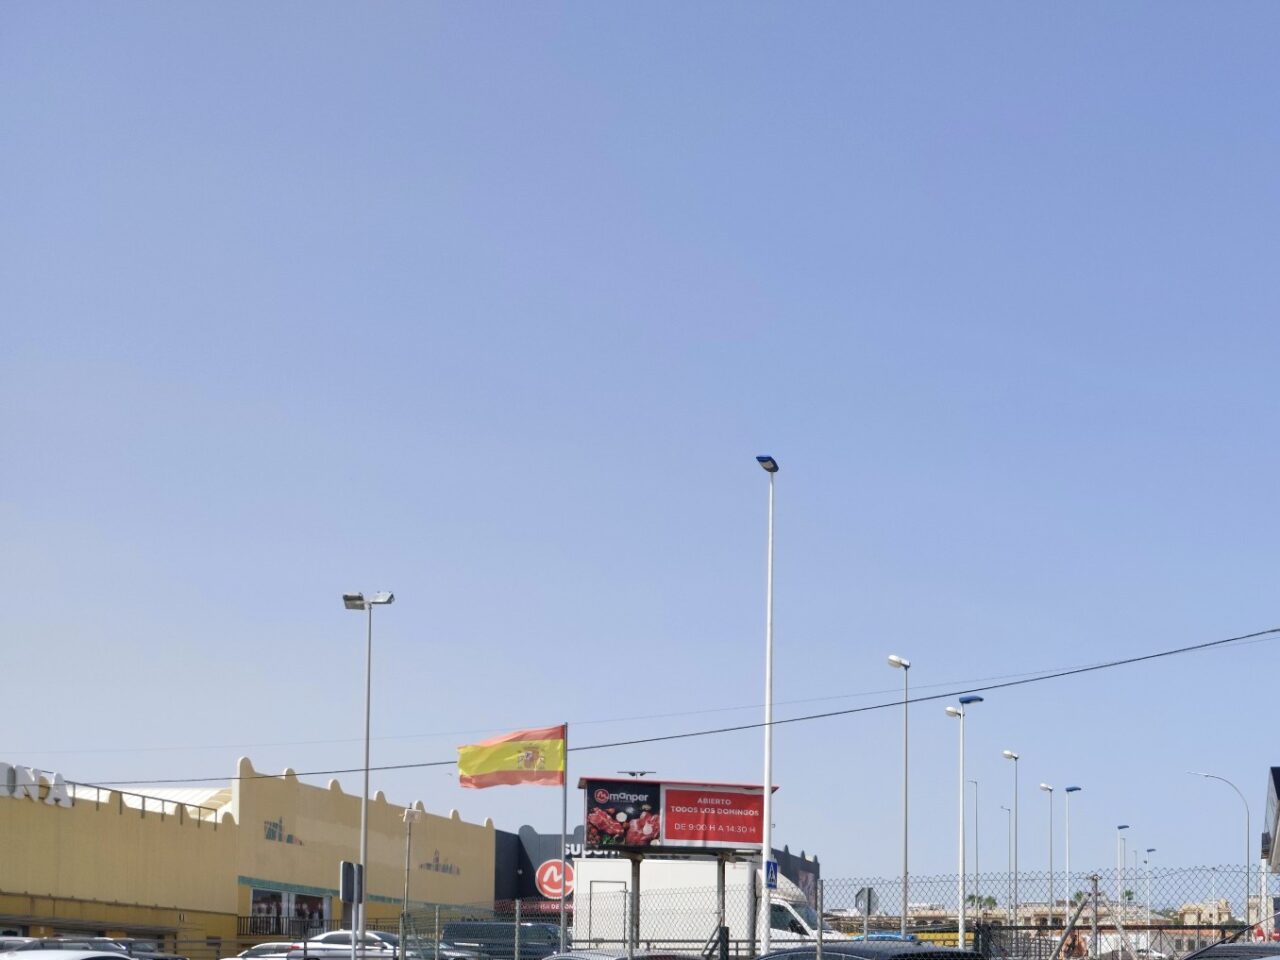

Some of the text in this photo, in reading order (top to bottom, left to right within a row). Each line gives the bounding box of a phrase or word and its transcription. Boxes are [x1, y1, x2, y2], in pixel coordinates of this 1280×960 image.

[609, 792, 649, 803] manper
[697, 798, 732, 806] ABIERTO
[671, 805, 699, 813] TODOS
[717, 808, 759, 816] DOMINGOS
